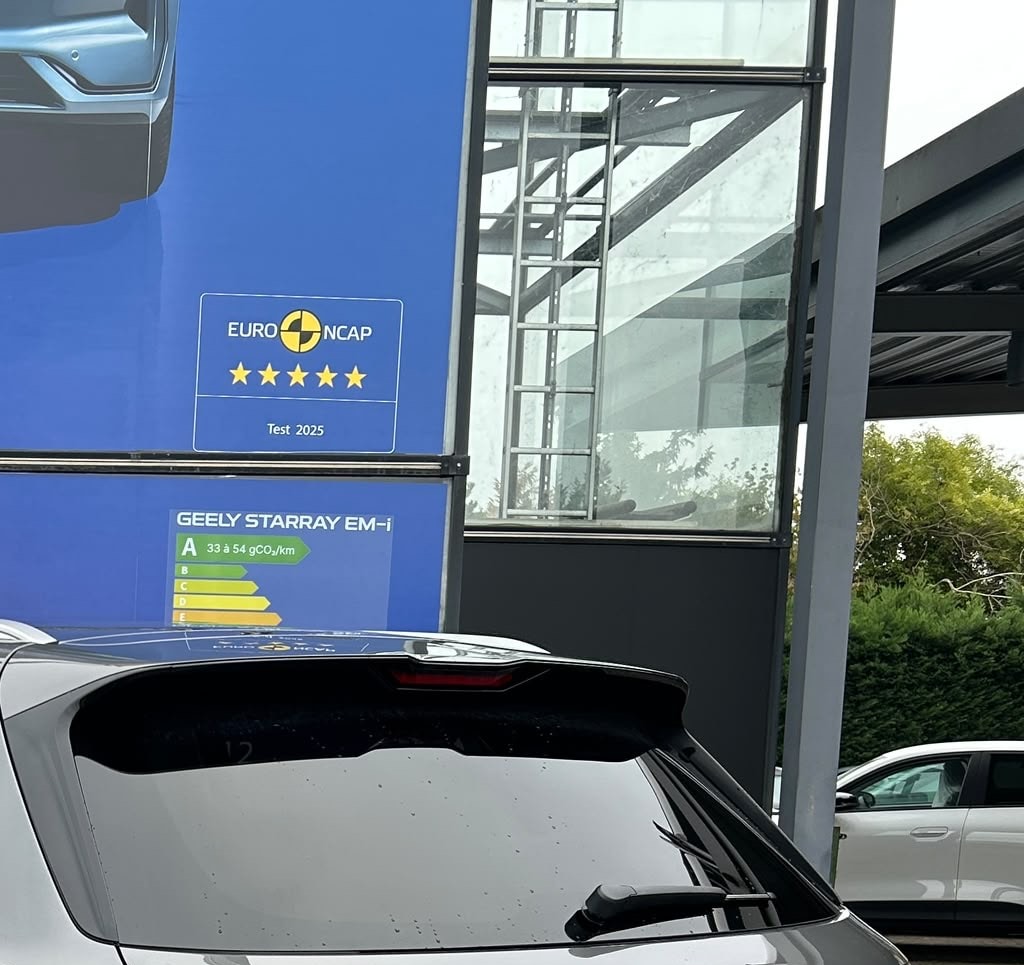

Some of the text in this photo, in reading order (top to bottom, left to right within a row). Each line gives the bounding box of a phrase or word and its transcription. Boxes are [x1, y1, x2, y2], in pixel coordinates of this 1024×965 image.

[228, 321, 373, 341] EURO NCAP
[267, 423, 324, 436] Test 2025
[176, 511, 392, 532] GEELY STARRAY EM-i
[181, 537, 197, 557] A
[207, 543, 220, 553] 33
[223, 543, 230, 554] à
[232, 544, 246, 554] 54
[181, 566, 189, 575] B
[180, 581, 188, 591] C
[179, 597, 187, 606] D
[179, 613, 186, 622] E
